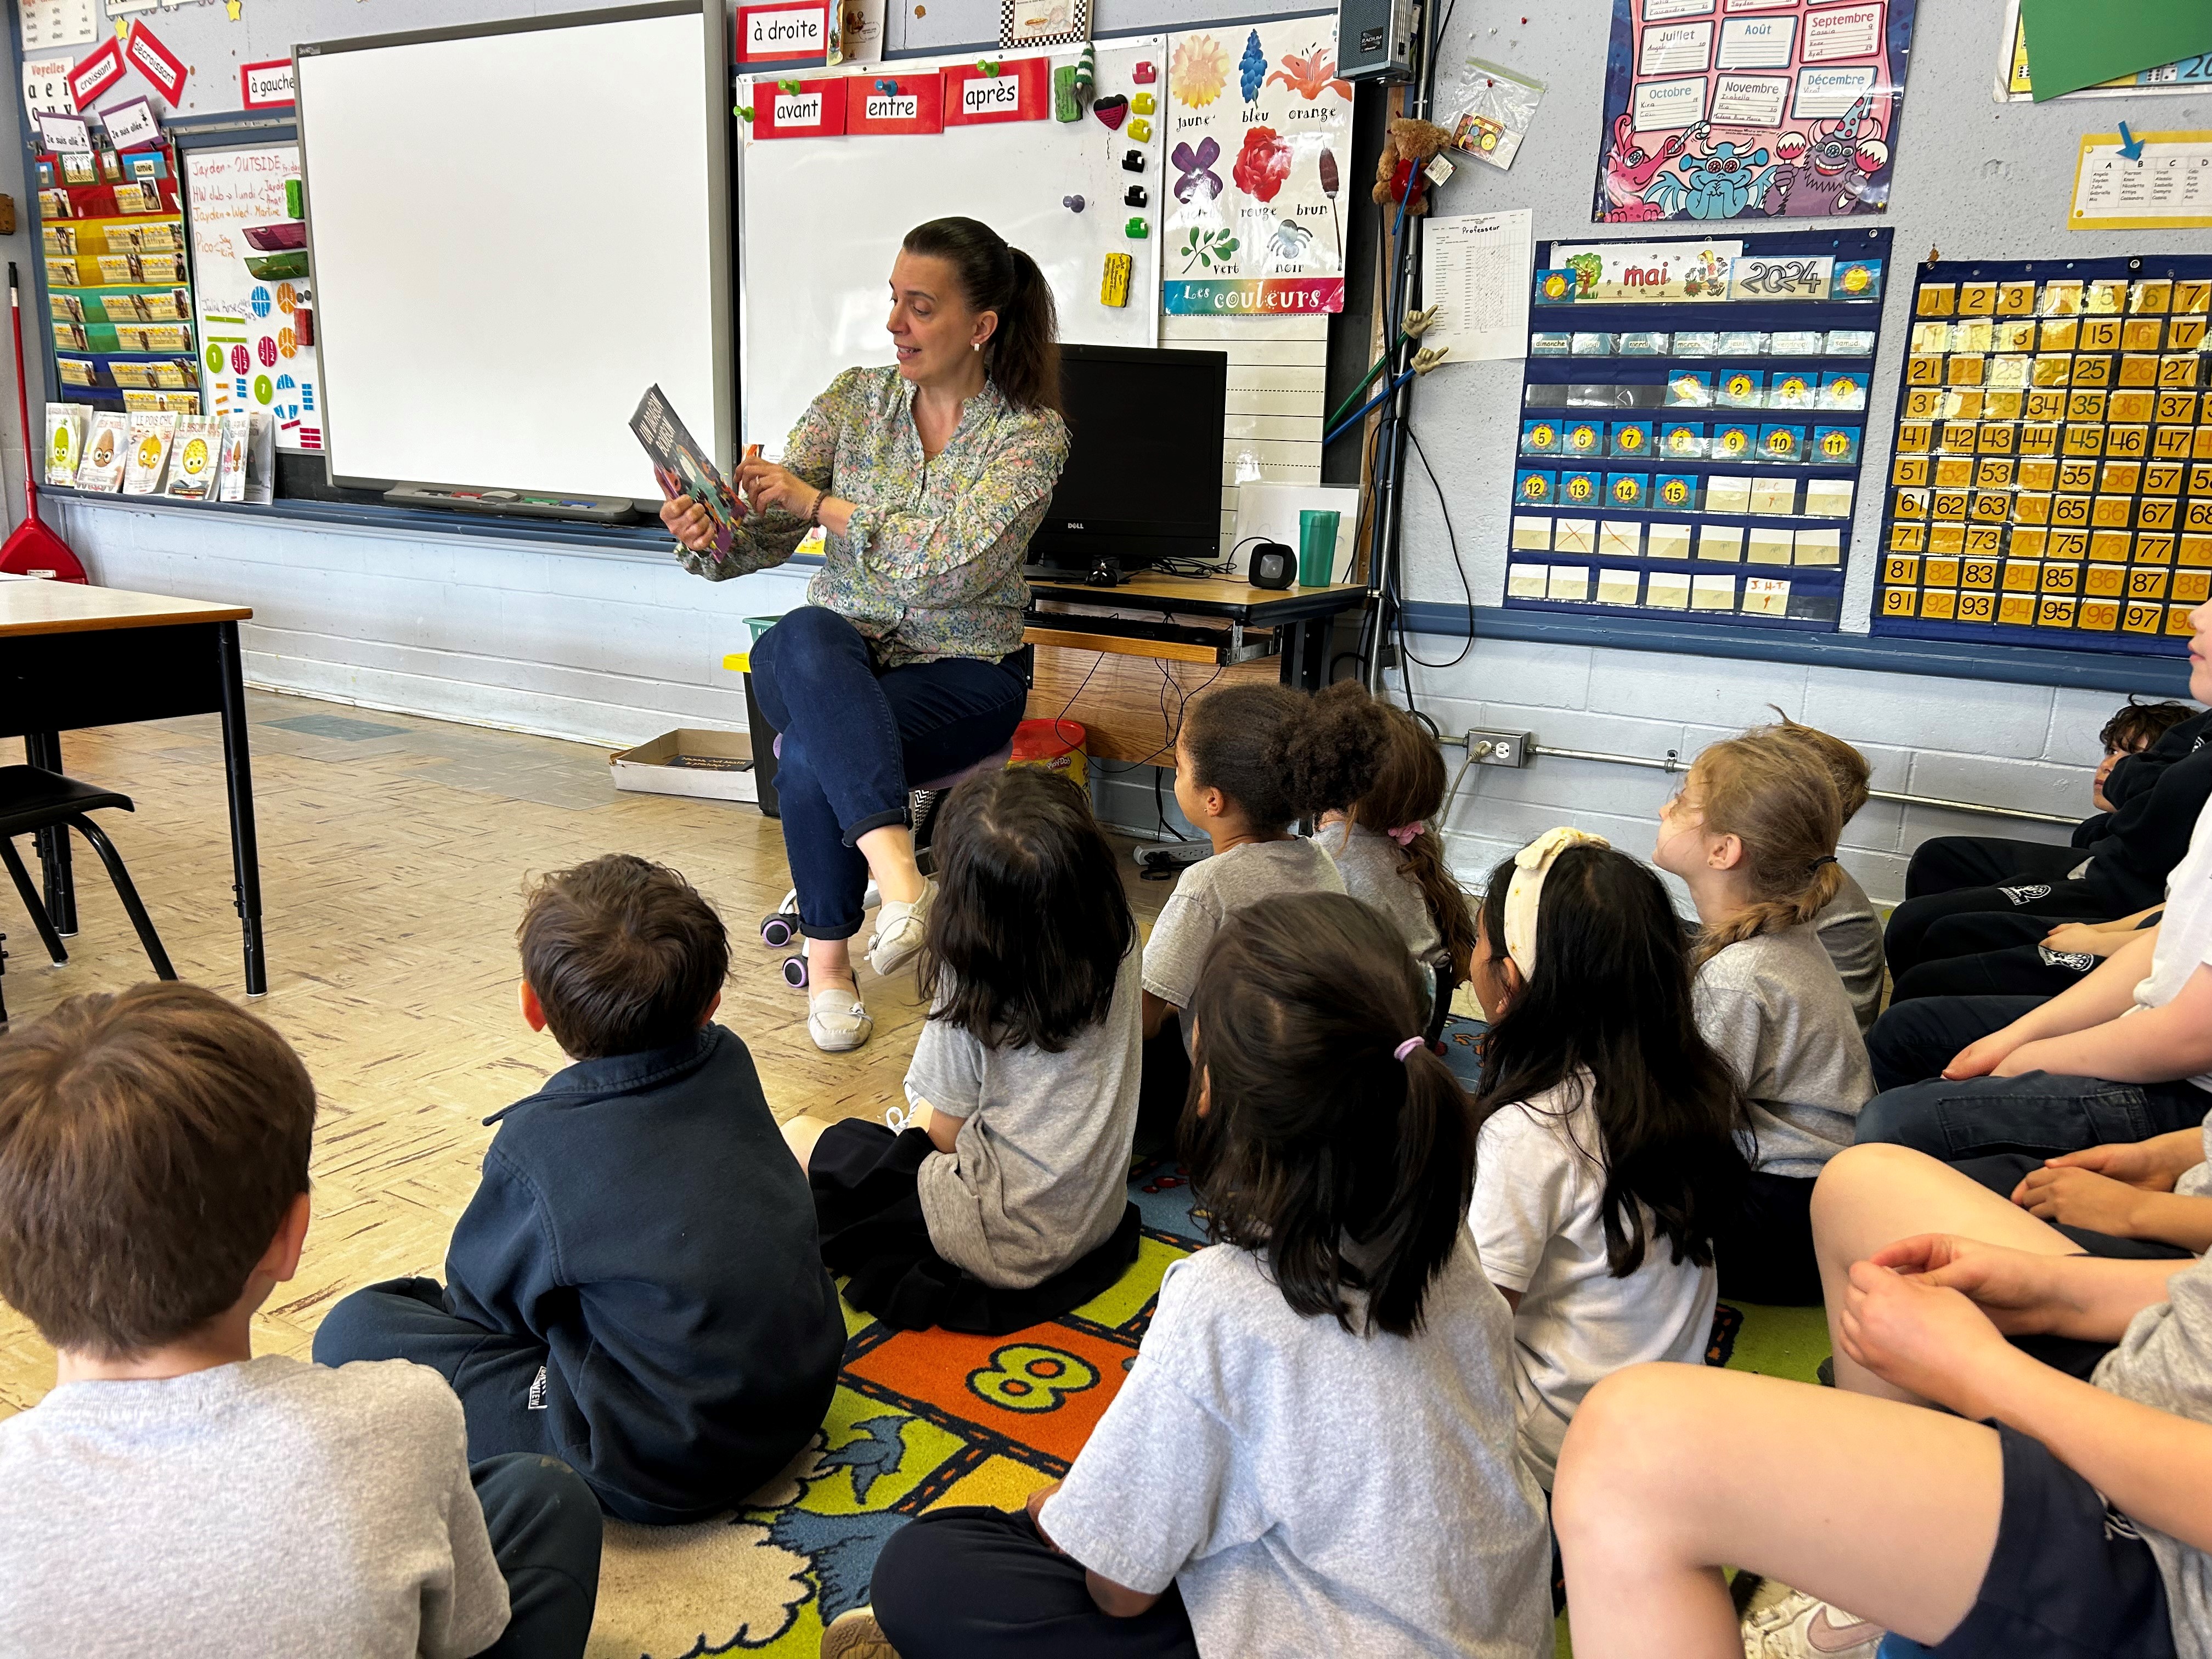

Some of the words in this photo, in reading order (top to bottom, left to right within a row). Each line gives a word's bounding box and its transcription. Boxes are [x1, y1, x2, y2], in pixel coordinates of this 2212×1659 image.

[1745, 24, 1771, 35] Août
[1812, 13, 1874, 28] Septembre
[754, 21, 763, 41] à
[769, 20, 817, 41] droite
[1660, 30, 1695, 41] Juillet
[31, 63, 65, 77] Voyelles
[133, 42, 177, 89] décroissant
[80, 60, 111, 91] croissant
[1808, 74, 1864, 85] Décembre
[29, 84, 37, 98] a
[46, 83, 52, 97] e
[63, 77, 68, 96] i
[252, 77, 258, 93] à
[261, 73, 294, 97] gauche
[1650, 87, 1691, 99] Octobre
[1725, 82, 1779, 94] Novembre
[965, 83, 1015, 108] après
[777, 100, 819, 120] avant
[868, 97, 914, 117] entre
[1242, 108, 1269, 122] bleu
[1289, 107, 1337, 122] orange
[1176, 116, 1210, 132] jaune
[46, 134, 54, 143] Je
[57, 136, 66, 144] suis
[192, 159, 224, 178] Jayden
[235, 155, 280, 172] OUTSIDE
[235, 182, 255, 199] lundi
[264, 179, 285, 191] Jayde
[193, 205, 224, 223] Jayden
[1241, 207, 1277, 221] rouge
[1296, 204, 1328, 216] brun
[1463, 225, 1499, 234] Professeur
[1214, 262, 1239, 275] vert
[1276, 263, 1304, 273] noir
[1624, 262, 1668, 286] mai
[1741, 261, 1821, 294] 2024
[1183, 285, 1210, 300] Les
[1214, 281, 1321, 309] couleurs
[1934, 290, 1940, 308] 1
[1970, 289, 1984, 308] 2
[2008, 289, 2023, 308] 3
[2186, 285, 2202, 304] 7
[2092, 324, 2113, 343] 15
[2175, 323, 2198, 342] 17
[1913, 360, 1936, 379] 21
[1996, 360, 2023, 380] 23
[2076, 360, 2106, 379] 25
[2165, 359, 2194, 379] 27
[1735, 383, 1743, 395] 2
[1788, 386, 1797, 398] 3
[1838, 386, 1846, 398] 4
[2029, 397, 2059, 414] 34
[2161, 398, 2192, 417] 37
[145, 416, 158, 425] POIS
[639, 420, 654, 444] UN
[1537, 432, 1545, 445] 5
[1578, 432, 1587, 445] 6
[1626, 433, 1634, 447] 7
[1902, 427, 1926, 445] 41
[1945, 428, 1974, 447] 42
[2069, 429, 2100, 448] 45
[2158, 432, 2190, 450] 47
[1675, 436, 1684, 450] 8
[1729, 437, 1737, 450] 9
[1772, 436, 1787, 450] 10
[1827, 439, 1841, 453] 11
[1901, 462, 1923, 480] 51
[1980, 463, 2010, 483] 53
[2062, 465, 2091, 485] 55
[2148, 469, 2179, 488] 57
[1527, 482, 1541, 495] 12
[1572, 483, 1585, 496] 13
[1618, 484, 1632, 498] 14
[1667, 486, 1681, 500] 15
[1978, 496, 2006, 515] 63
[2057, 500, 2085, 520] 65
[2142, 504, 2172, 523] 67
[1898, 528, 1919, 546] 71
[2057, 534, 2084, 553] 75
[2140, 539, 2171, 558] 77
[1891, 560, 1913, 578] 81
[1965, 565, 1993, 583] 83
[2046, 568, 2074, 588] 85
[1888, 592, 1910, 611] 91
[1961, 597, 1989, 616] 93
[2042, 602, 2072, 622] 95
[2128, 608, 2159, 628] 97
[965, 1343, 1102, 1414] 8
